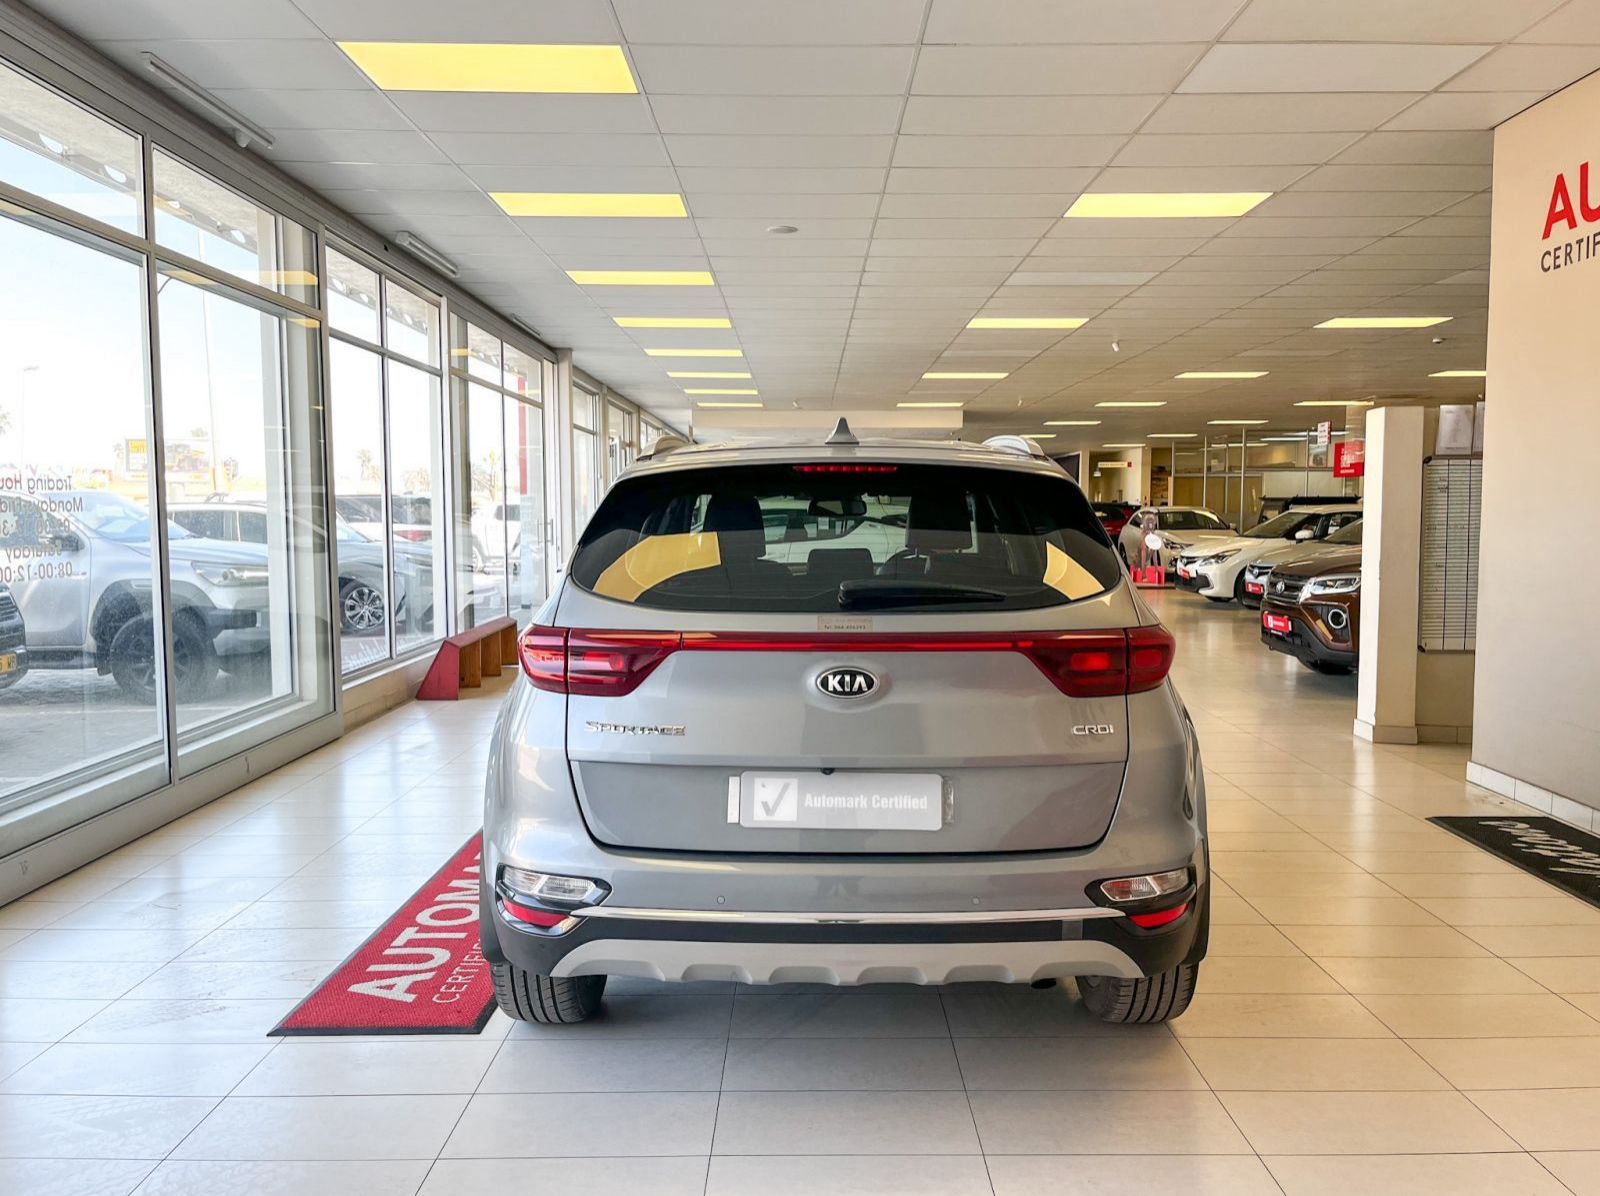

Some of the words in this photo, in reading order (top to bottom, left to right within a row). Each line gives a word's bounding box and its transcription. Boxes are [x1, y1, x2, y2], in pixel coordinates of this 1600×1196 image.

[827, 674, 868, 692] KIA
[804, 793, 868, 809] Automark
[872, 794, 928, 810] Certified
